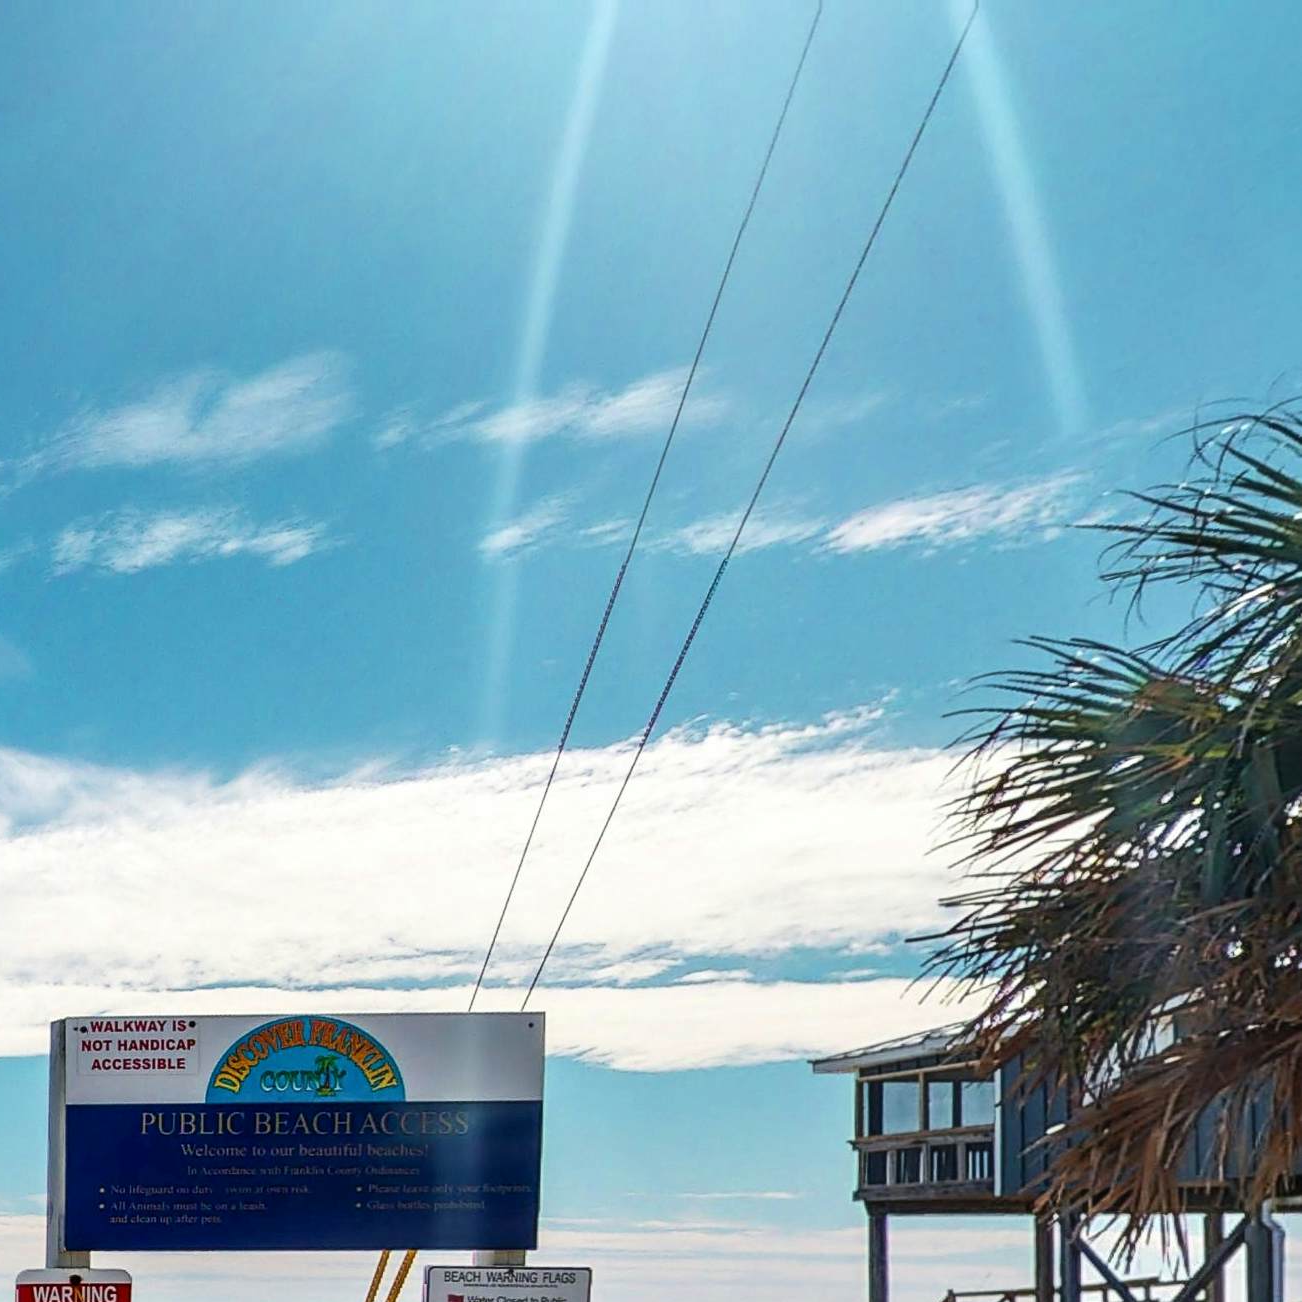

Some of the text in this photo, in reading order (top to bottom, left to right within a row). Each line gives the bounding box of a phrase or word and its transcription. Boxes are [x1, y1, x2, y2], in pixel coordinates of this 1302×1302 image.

[90, 1020, 187, 1033] WALKWAY IS
[81, 1039, 196, 1051] NOT HANDICAP
[214, 1020, 397, 1093] DISCOVER FRANKLIN
[92, 1058, 186, 1070] ACCESSIBLE
[141, 1111, 469, 1135] PUBLIC BEACH ACCESS
[181, 1143, 428, 1157] Welcome to our beautiful beaches!
[444, 1271, 576, 1284] BEACH WARNING FLAGS
